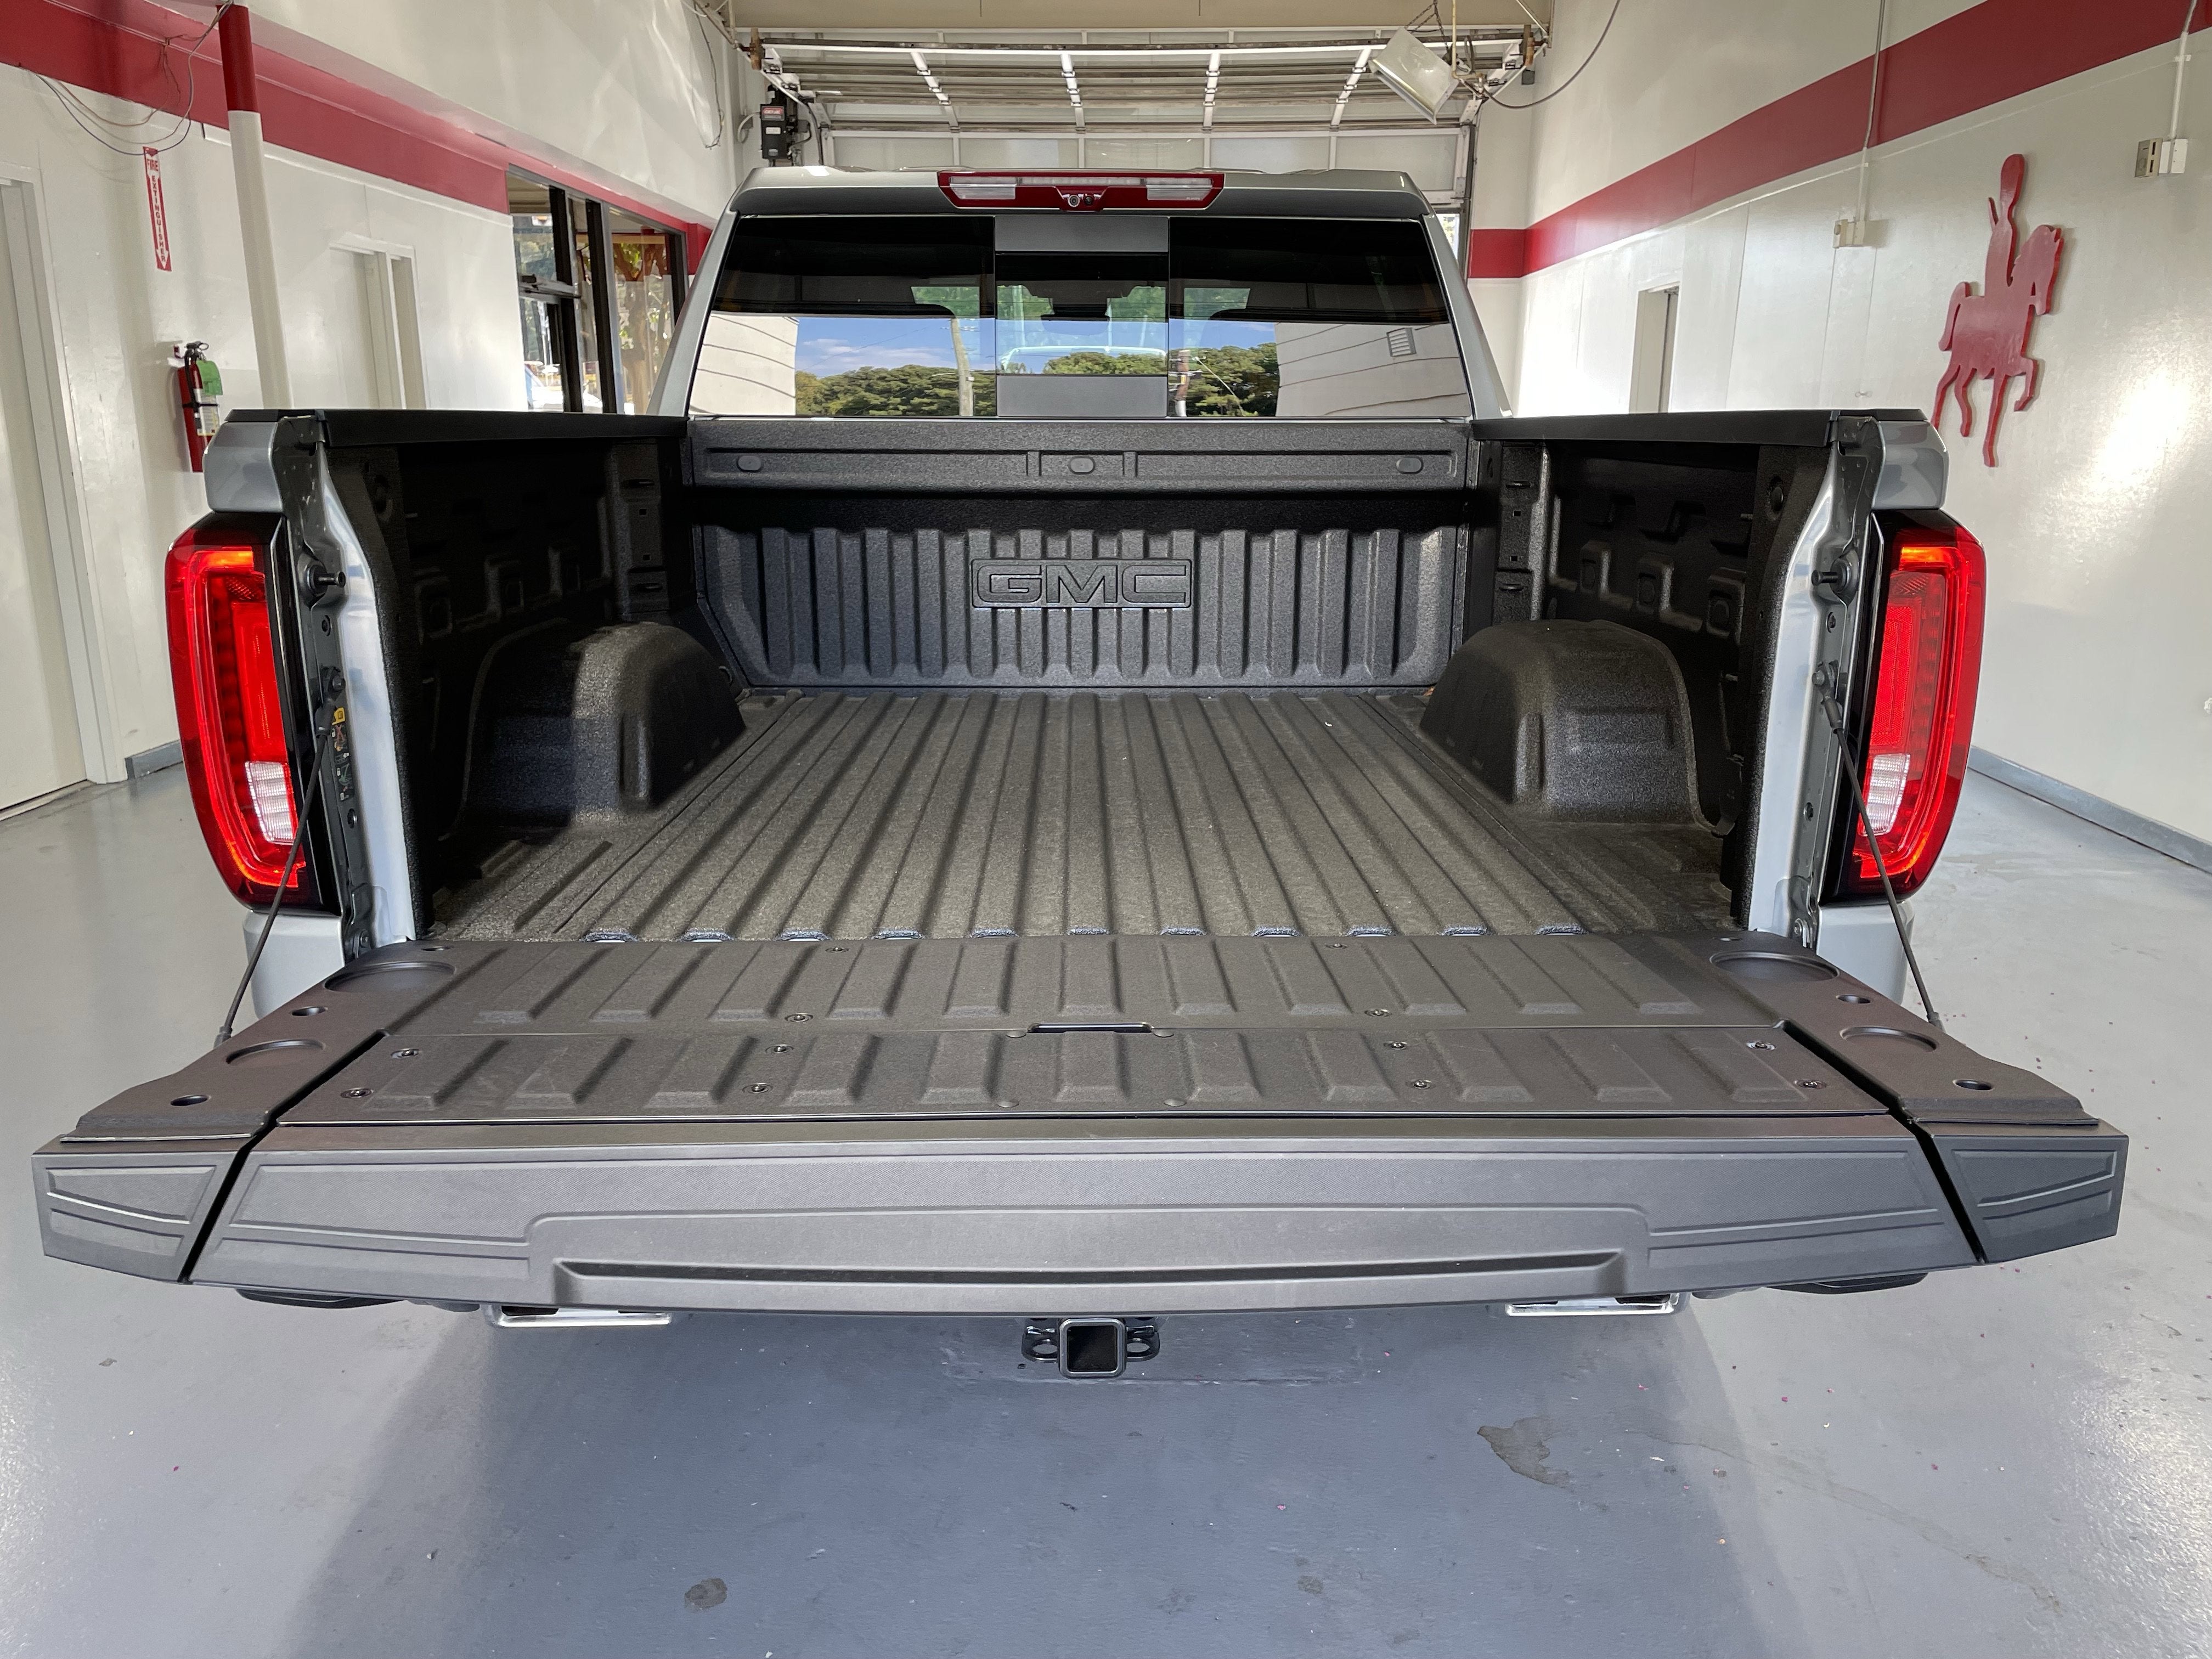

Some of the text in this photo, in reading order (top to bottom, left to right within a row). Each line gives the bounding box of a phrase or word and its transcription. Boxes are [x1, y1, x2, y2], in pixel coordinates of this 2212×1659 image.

[147, 159, 159, 171] FIRE
[152, 175, 166, 262] EXTINGUISHER
[977, 565, 1187, 603] GMC
